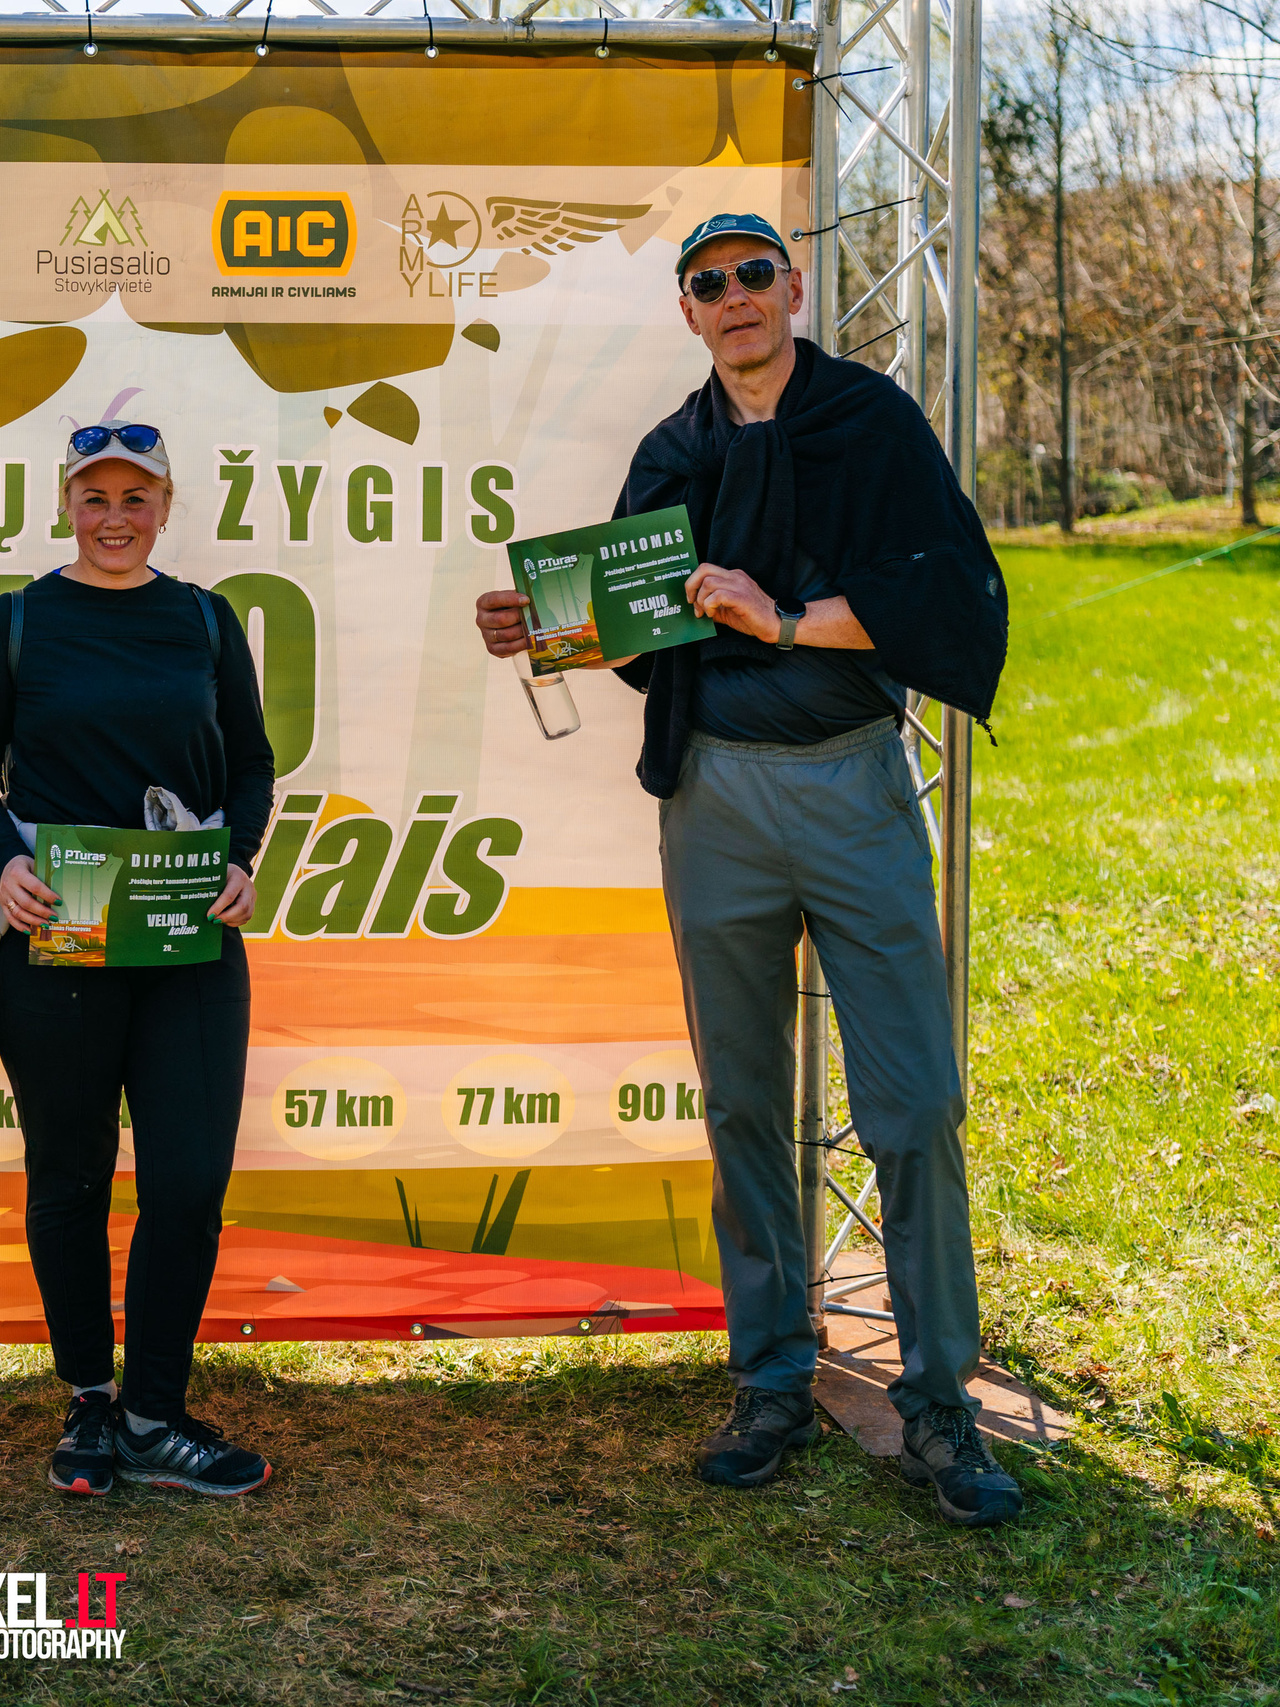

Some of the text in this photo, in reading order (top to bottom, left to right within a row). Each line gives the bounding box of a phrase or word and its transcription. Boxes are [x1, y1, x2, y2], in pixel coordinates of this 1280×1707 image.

[233, 209, 336, 258] AIC
[35, 249, 171, 277] Pusiasalio
[53, 276, 153, 296] Stovyklavietė
[211, 285, 357, 299] ARMIJAI IR CIVILIAMS
[216, 447, 516, 545] ŽYGIS
[599, 528, 684, 560] DIPLOMAS
[538, 554, 578, 569] PTuras
[629, 594, 669, 614] VELNIO
[653, 604, 681, 619] keliais
[65, 849, 106, 861] PTuras
[131, 849, 220, 868] DIPLOMAS
[241, 794, 523, 936] iais
[146, 912, 187, 927] VELNIO
[167, 924, 199, 936] keliais
[284, 1089, 394, 1128] 57 km
[457, 1087, 560, 1126] 77 km
[618, 1083, 704, 1122] 90 k
